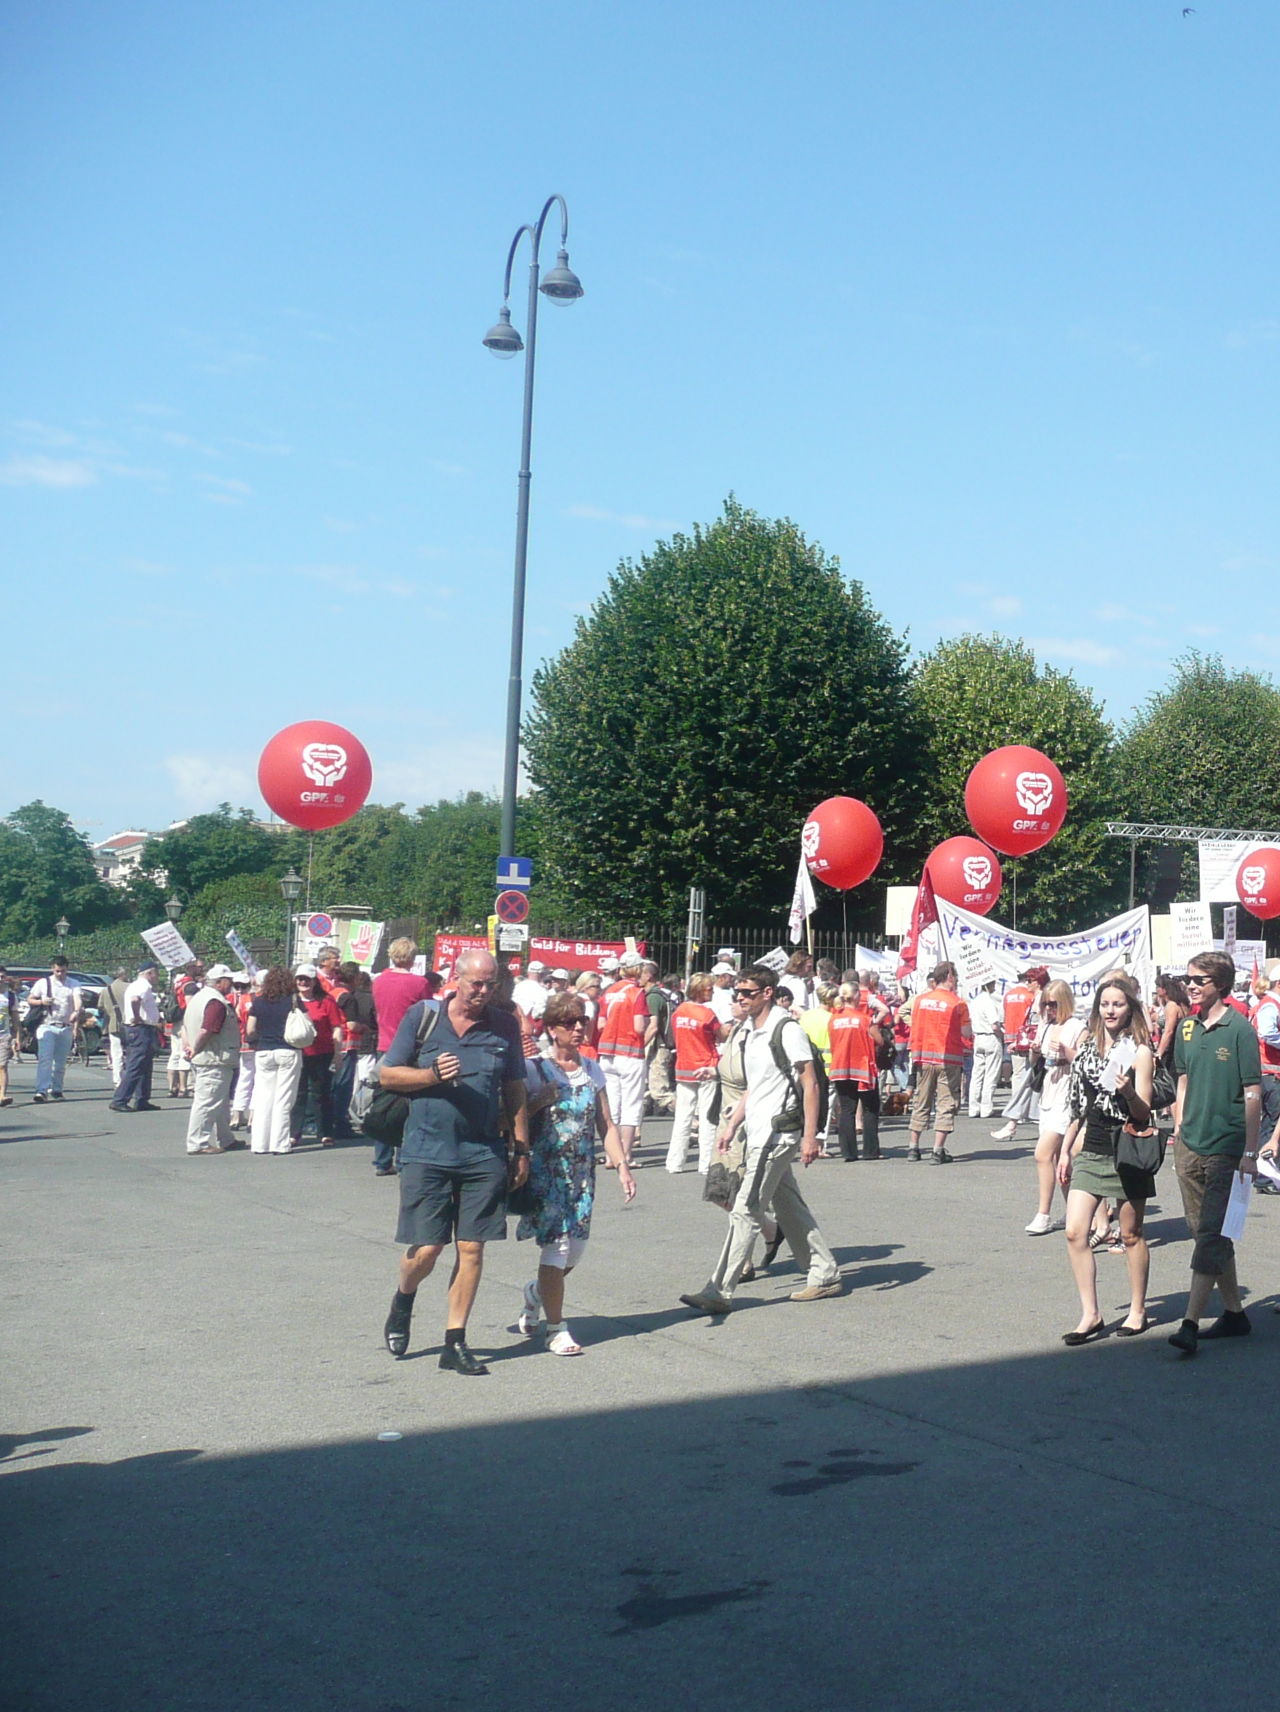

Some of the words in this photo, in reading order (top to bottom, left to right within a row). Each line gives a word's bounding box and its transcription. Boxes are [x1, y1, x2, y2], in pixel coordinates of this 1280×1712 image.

[531, 938, 553, 949] Geld
[555, 941, 571, 952] für
[1182, 1020, 1195, 1041] 2
